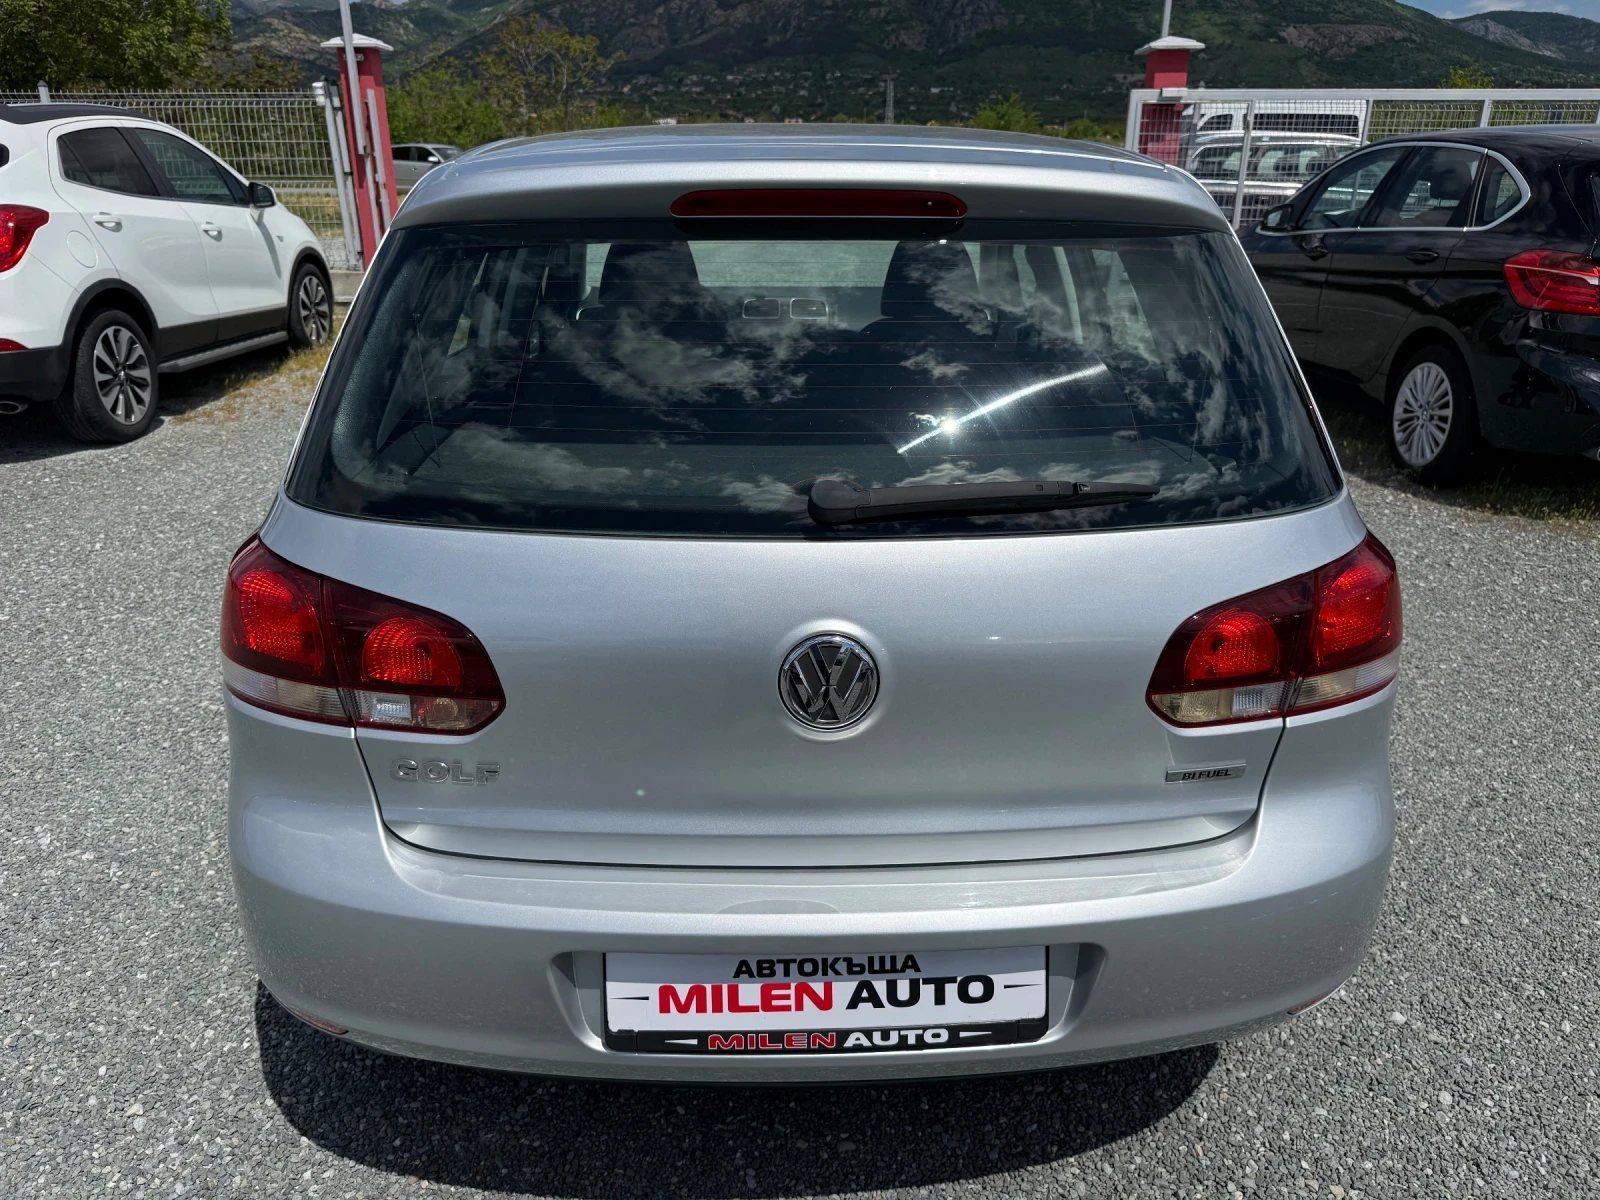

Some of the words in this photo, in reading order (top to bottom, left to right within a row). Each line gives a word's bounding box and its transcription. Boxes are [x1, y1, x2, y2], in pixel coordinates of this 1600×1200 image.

[390, 758, 500, 785] GOLF
[1198, 769, 1231, 779] FUEL
[658, 981, 833, 1014] MILEN
[845, 974, 995, 1010] AUTO
[707, 1032, 836, 1050] MILEN
[842, 1028, 949, 1047] AUTO
